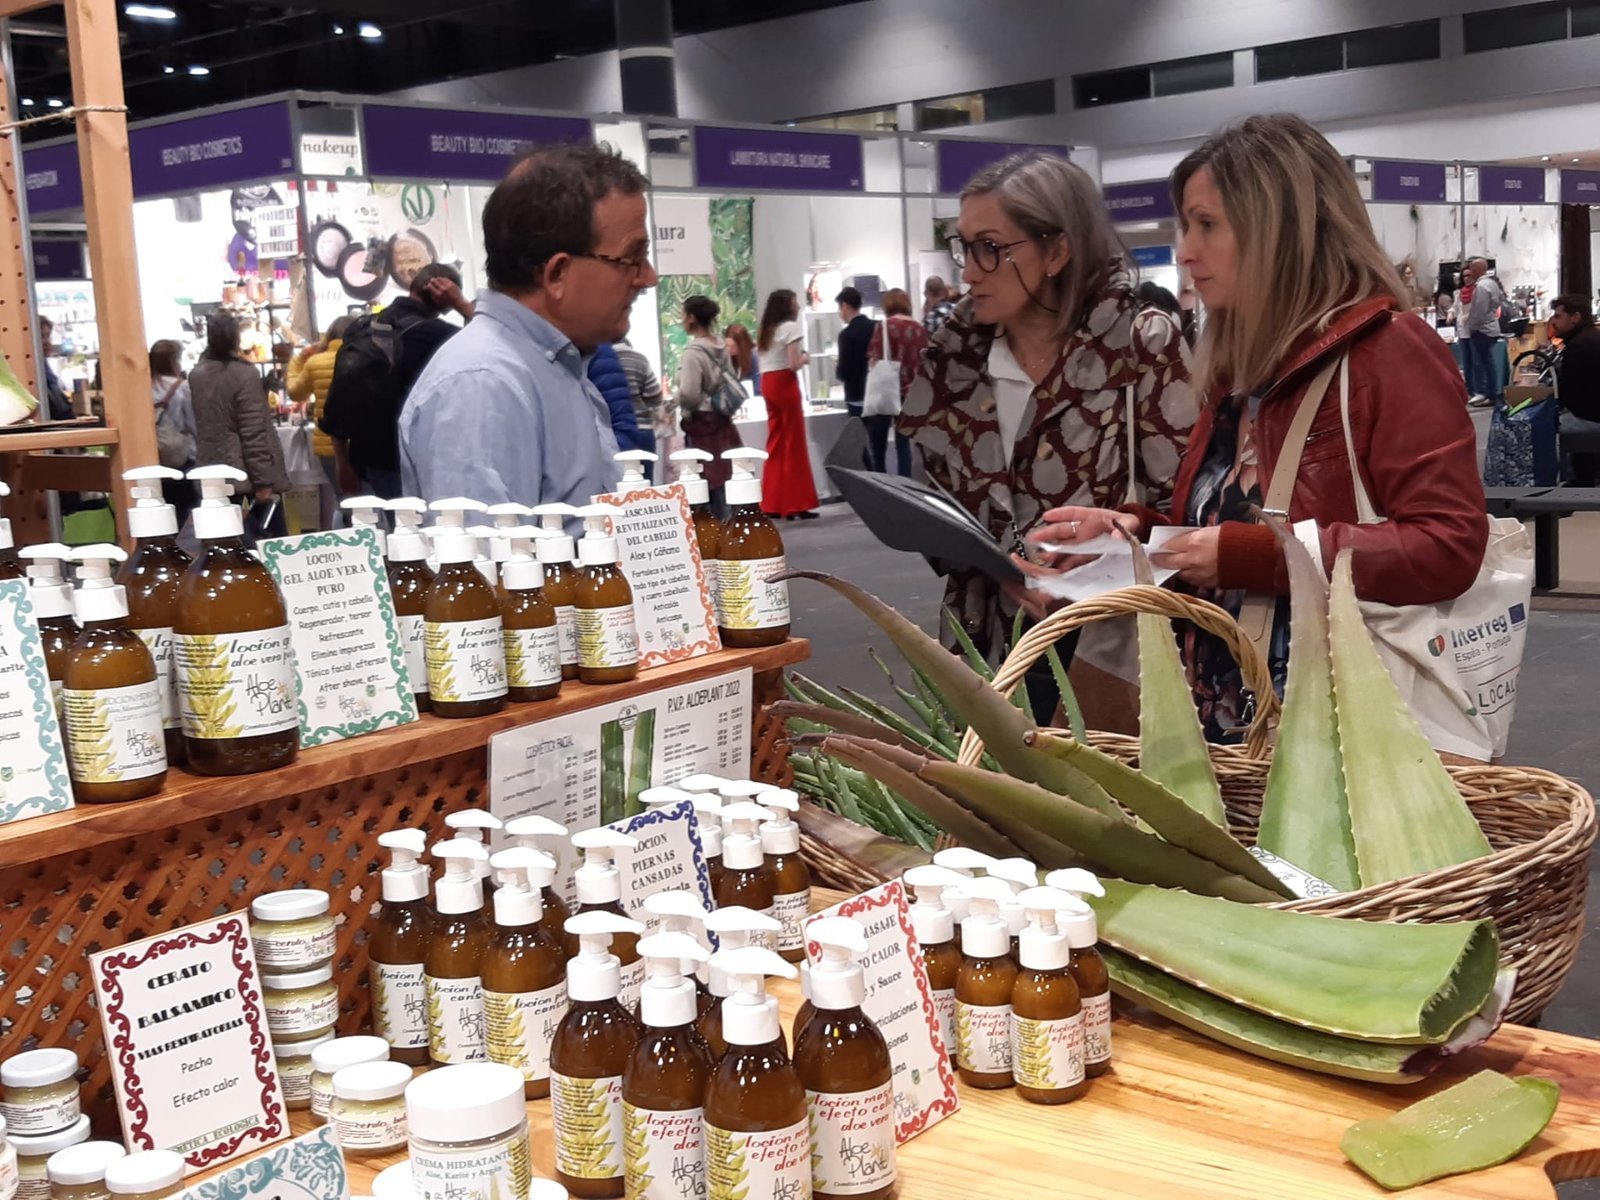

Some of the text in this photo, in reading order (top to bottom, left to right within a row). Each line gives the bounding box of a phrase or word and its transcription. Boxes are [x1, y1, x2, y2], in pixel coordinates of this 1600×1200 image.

[162, 136, 243, 166] BEAUTY BIO COSMETICS
[431, 135, 466, 153] BEAUTY
[469, 136, 485, 154] BIO
[616, 516, 678, 534] REVITALIZANTE
[626, 530, 678, 546] DEL CABELLO
[306, 551, 343, 566] LOCION
[630, 551, 647, 561] Aloe
[647, 552, 652, 560] y
[283, 563, 367, 585] GEL ALOE VERA
[316, 582, 345, 596] PURO
[323, 599, 340, 611] cutis
[342, 600, 346, 609] y
[348, 594, 373, 606] cabello
[319, 628, 364, 641] Refrescante
[1451, 614, 1508, 648] Interreg
[230, 638, 280, 653] loción
[457, 639, 478, 649] aloe
[231, 654, 282, 667] aloe vera
[470, 654, 493, 672] Aloe
[246, 673, 277, 699] Aloe
[319, 682, 341, 693] After
[725, 680, 740, 698] 2022
[1479, 678, 1516, 707] LOCAL
[250, 691, 292, 716] Plant
[126, 729, 149, 745] Aloe
[632, 849, 675, 873] PIERNAS
[631, 863, 684, 890] CANSADAS
[872, 942, 902, 964] CALOR
[147, 961, 212, 990] CERATO
[870, 970, 902, 996] y Sauce
[434, 982, 469, 993] loción
[137, 988, 236, 1029] BALSAMICO
[514, 996, 552, 1008] loción
[138, 1018, 244, 1061] VIAS RESPIRATORIAS
[181, 1057, 213, 1074] Pecho
[173, 1077, 239, 1108] Efecto calor
[814, 1093, 860, 1107] loción
[646, 1113, 693, 1126] loción
[819, 1105, 868, 1121] efecto
[841, 1113, 890, 1131] aloe vera
[213, 1115, 259, 1139] ECOLOGICA
[652, 1125, 700, 1140] efecto
[673, 1136, 700, 1150] aloe
[745, 1133, 791, 1148] loción
[839, 1137, 871, 1162] Aloe
[751, 1142, 798, 1162] efecto
[415, 1157, 444, 1169] CREMA
[672, 1156, 704, 1179] Aloe
[774, 1155, 797, 1171] aloe
[843, 1150, 888, 1178] Plant
[772, 1176, 800, 1200] Aloe
